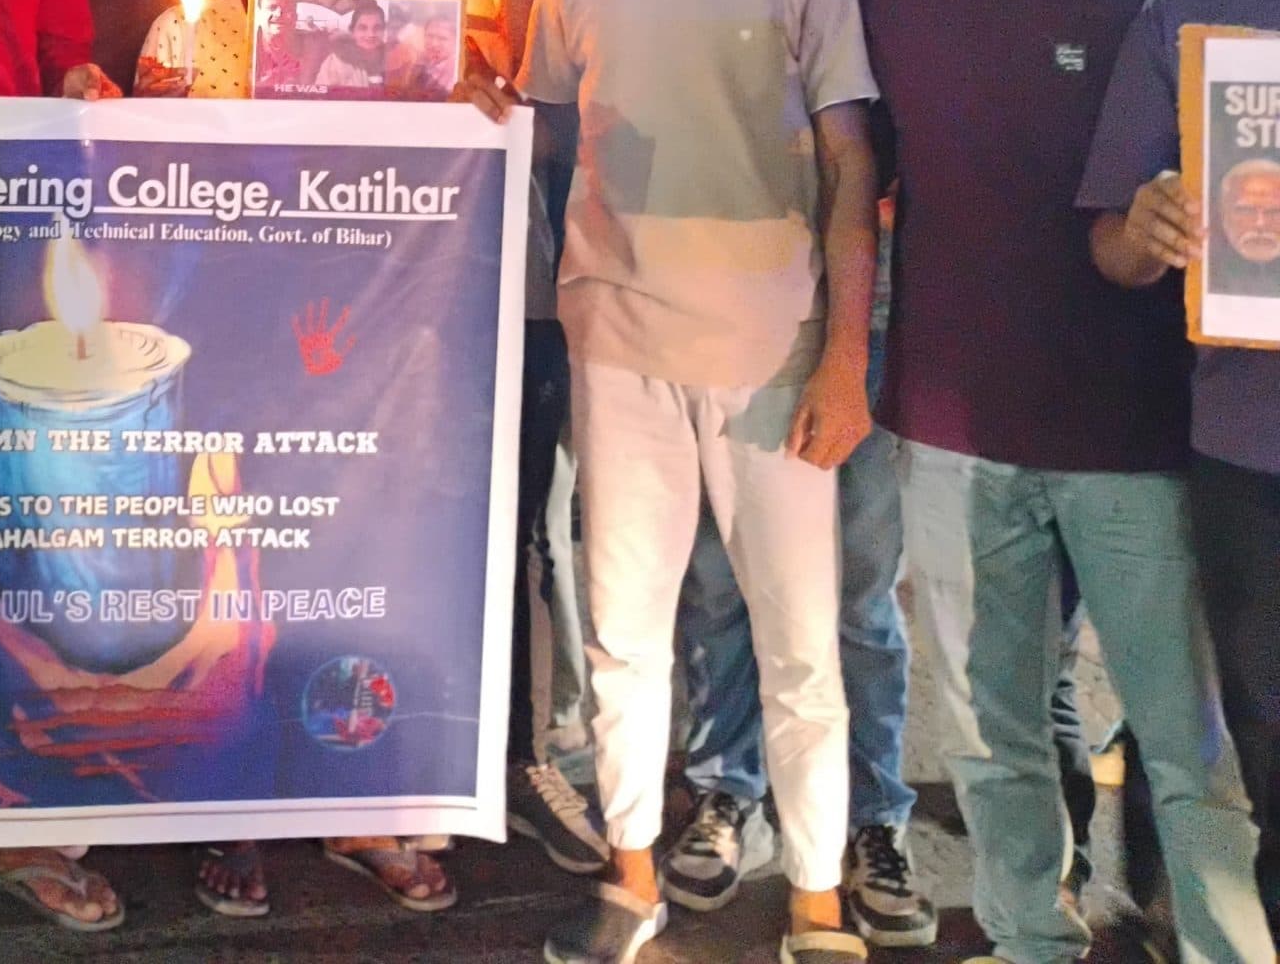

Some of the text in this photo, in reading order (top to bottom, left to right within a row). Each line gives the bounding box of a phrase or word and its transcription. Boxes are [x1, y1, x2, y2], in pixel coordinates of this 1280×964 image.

[108, 162, 283, 221] College,
[298, 167, 460, 216] Katihar
[28, 220, 62, 240] and
[71, 223, 155, 240] Technical
[258, 225, 308, 244] Govt.
[311, 227, 332, 244] of
[336, 227, 393, 249] Bihar)
[47, 430, 111, 452] THE
[121, 430, 245, 454] TERROR
[253, 431, 379, 454] ATTACK
[19, 496, 53, 516] TO
[59, 495, 109, 516] THE
[115, 495, 206, 516] PEOPLE
[211, 496, 274, 517] WHO
[279, 496, 340, 517] LOST
[111, 528, 210, 549] TERROR
[214, 528, 311, 549] ATTACK
[99, 588, 202, 623] REST
[210, 588, 252, 621] IN
[259, 586, 386, 621] PEACE
